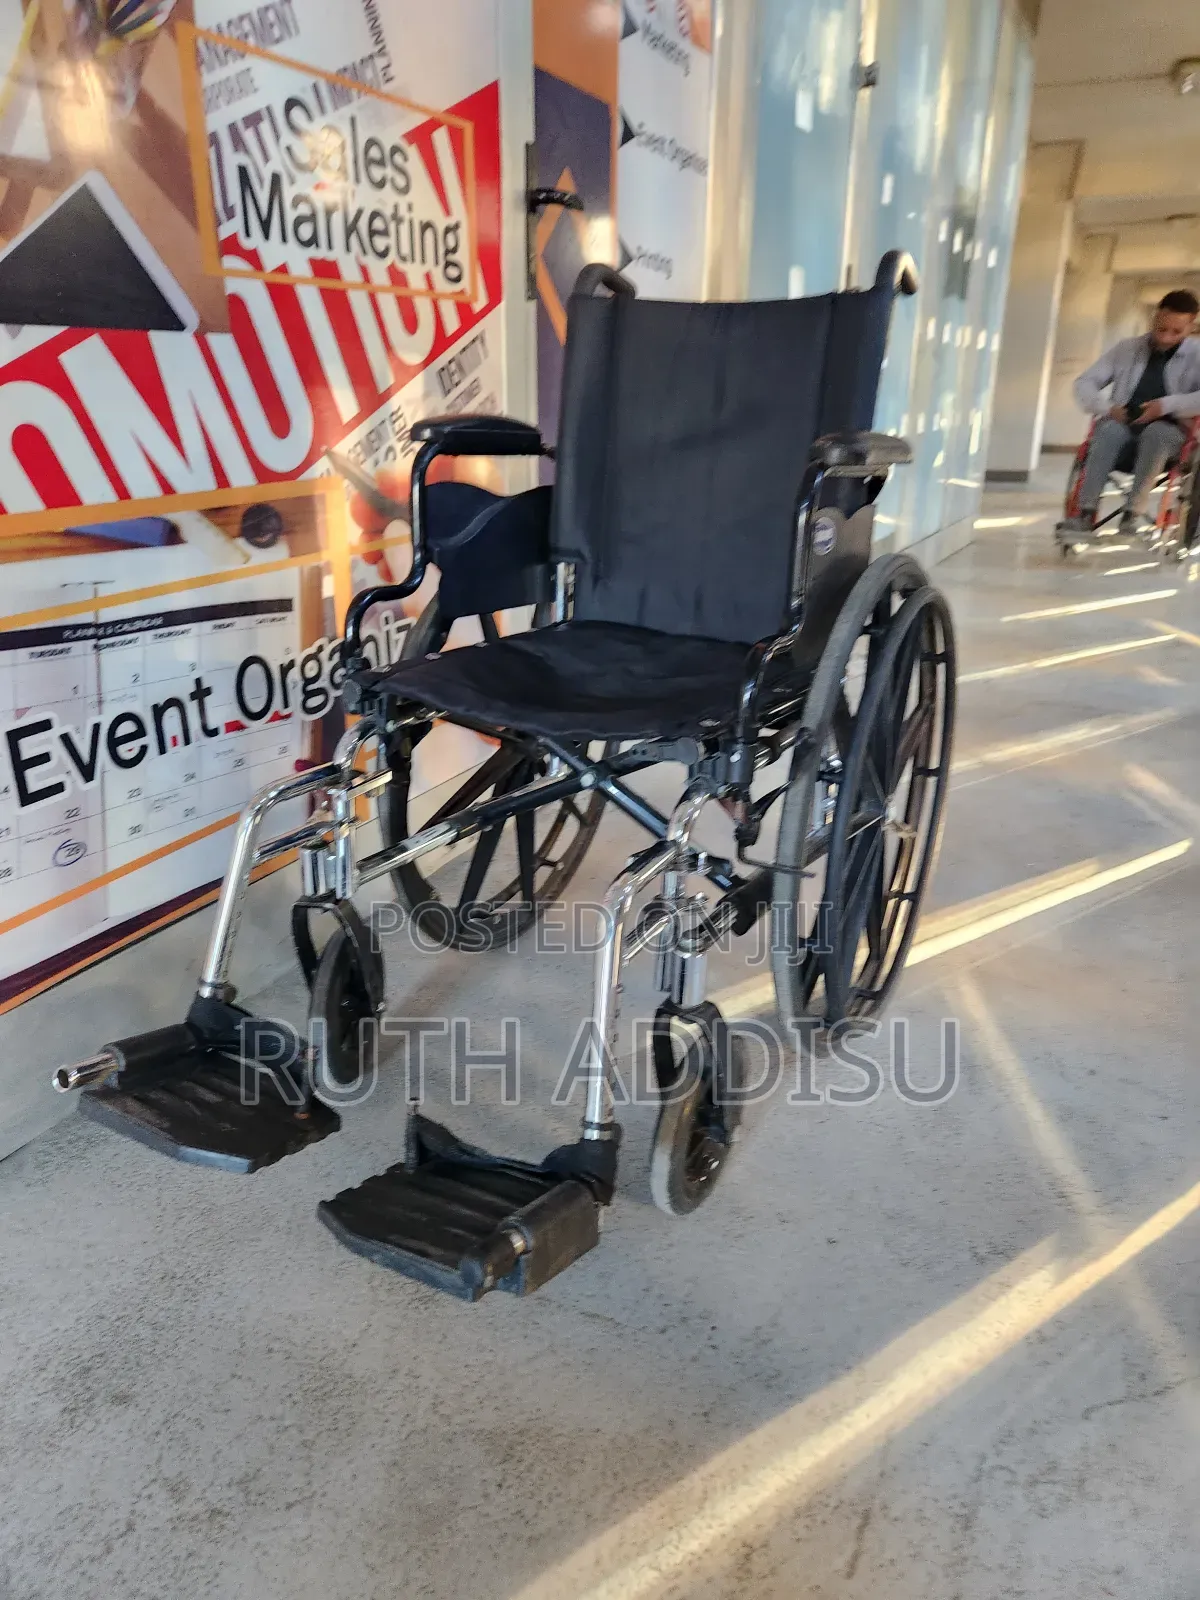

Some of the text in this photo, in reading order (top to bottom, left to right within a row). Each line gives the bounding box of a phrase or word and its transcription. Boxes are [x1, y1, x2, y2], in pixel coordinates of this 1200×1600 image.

[284, 96, 412, 196] Sales
[237, 164, 462, 284] Marketing
[131, 672, 140, 684] 2
[7, 677, 219, 807] Event
